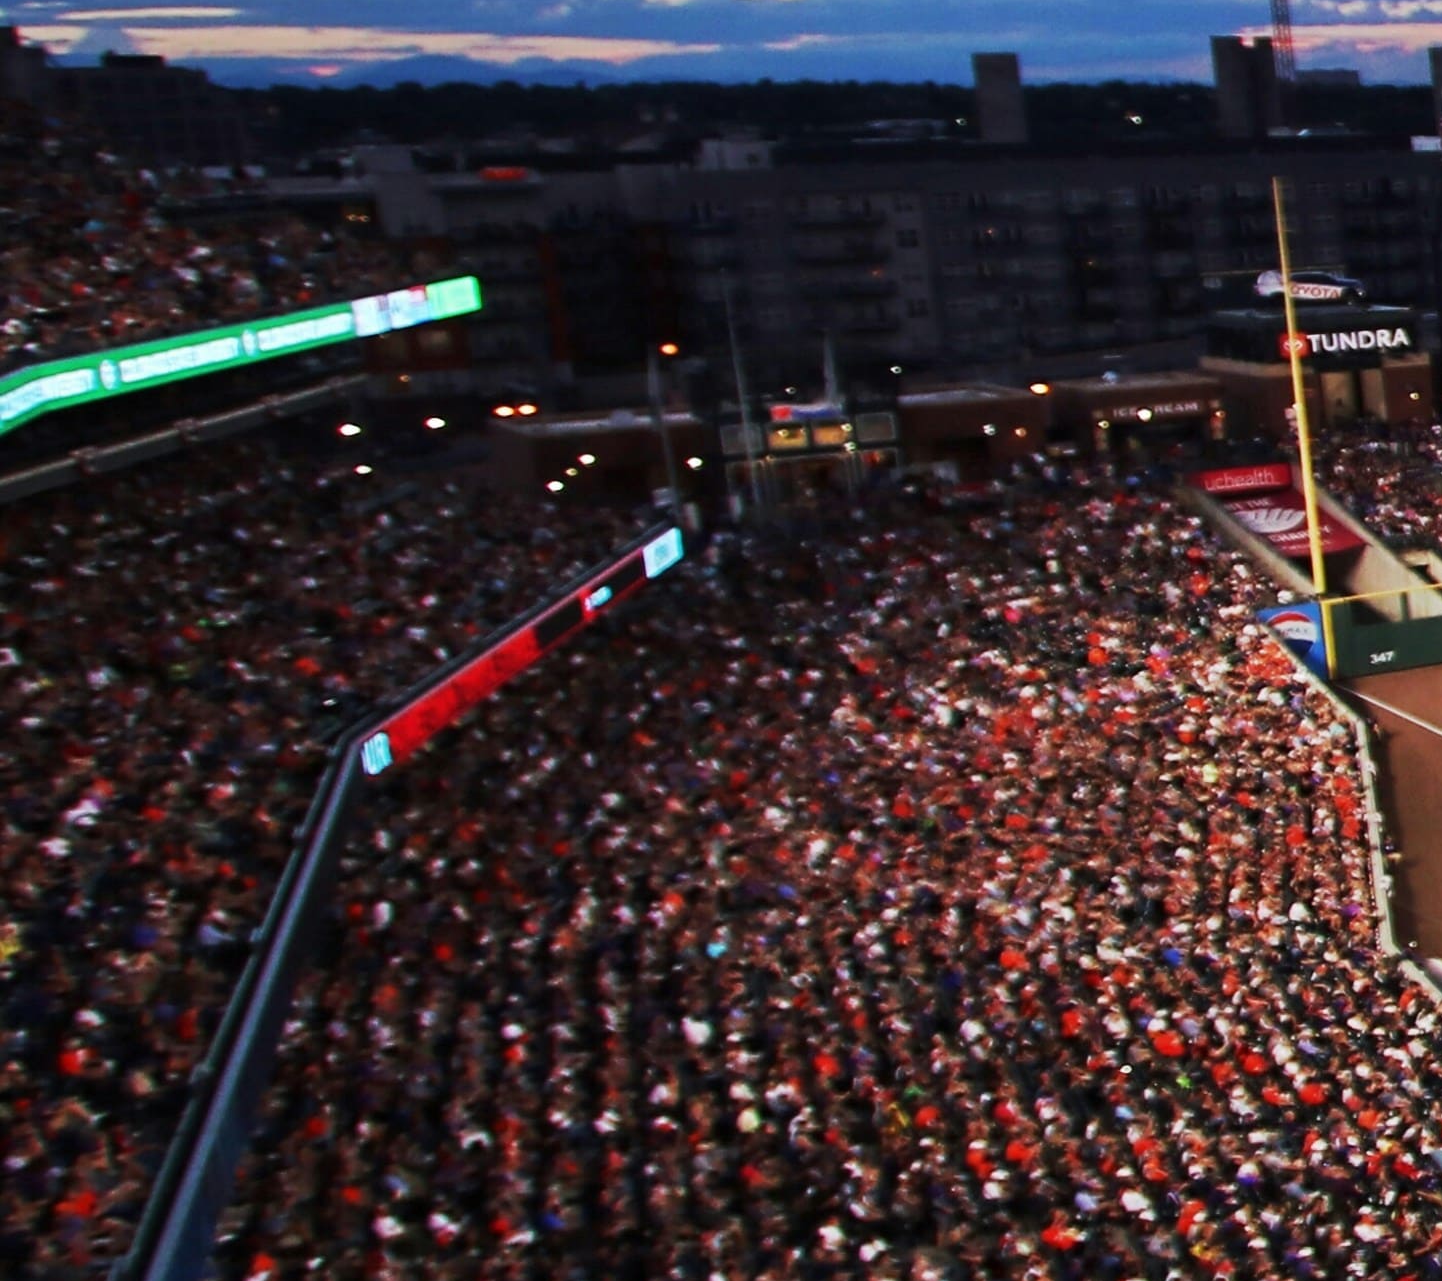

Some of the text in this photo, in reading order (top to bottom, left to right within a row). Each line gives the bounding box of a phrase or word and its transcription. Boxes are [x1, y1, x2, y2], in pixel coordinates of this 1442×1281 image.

[1288, 284, 1340, 299] OYOTA
[1307, 328, 1409, 353] TUNDRA
[1114, 402, 1198, 417] ICE REAM
[1205, 469, 1275, 490] uchealth
[1370, 650, 1395, 664] 347
